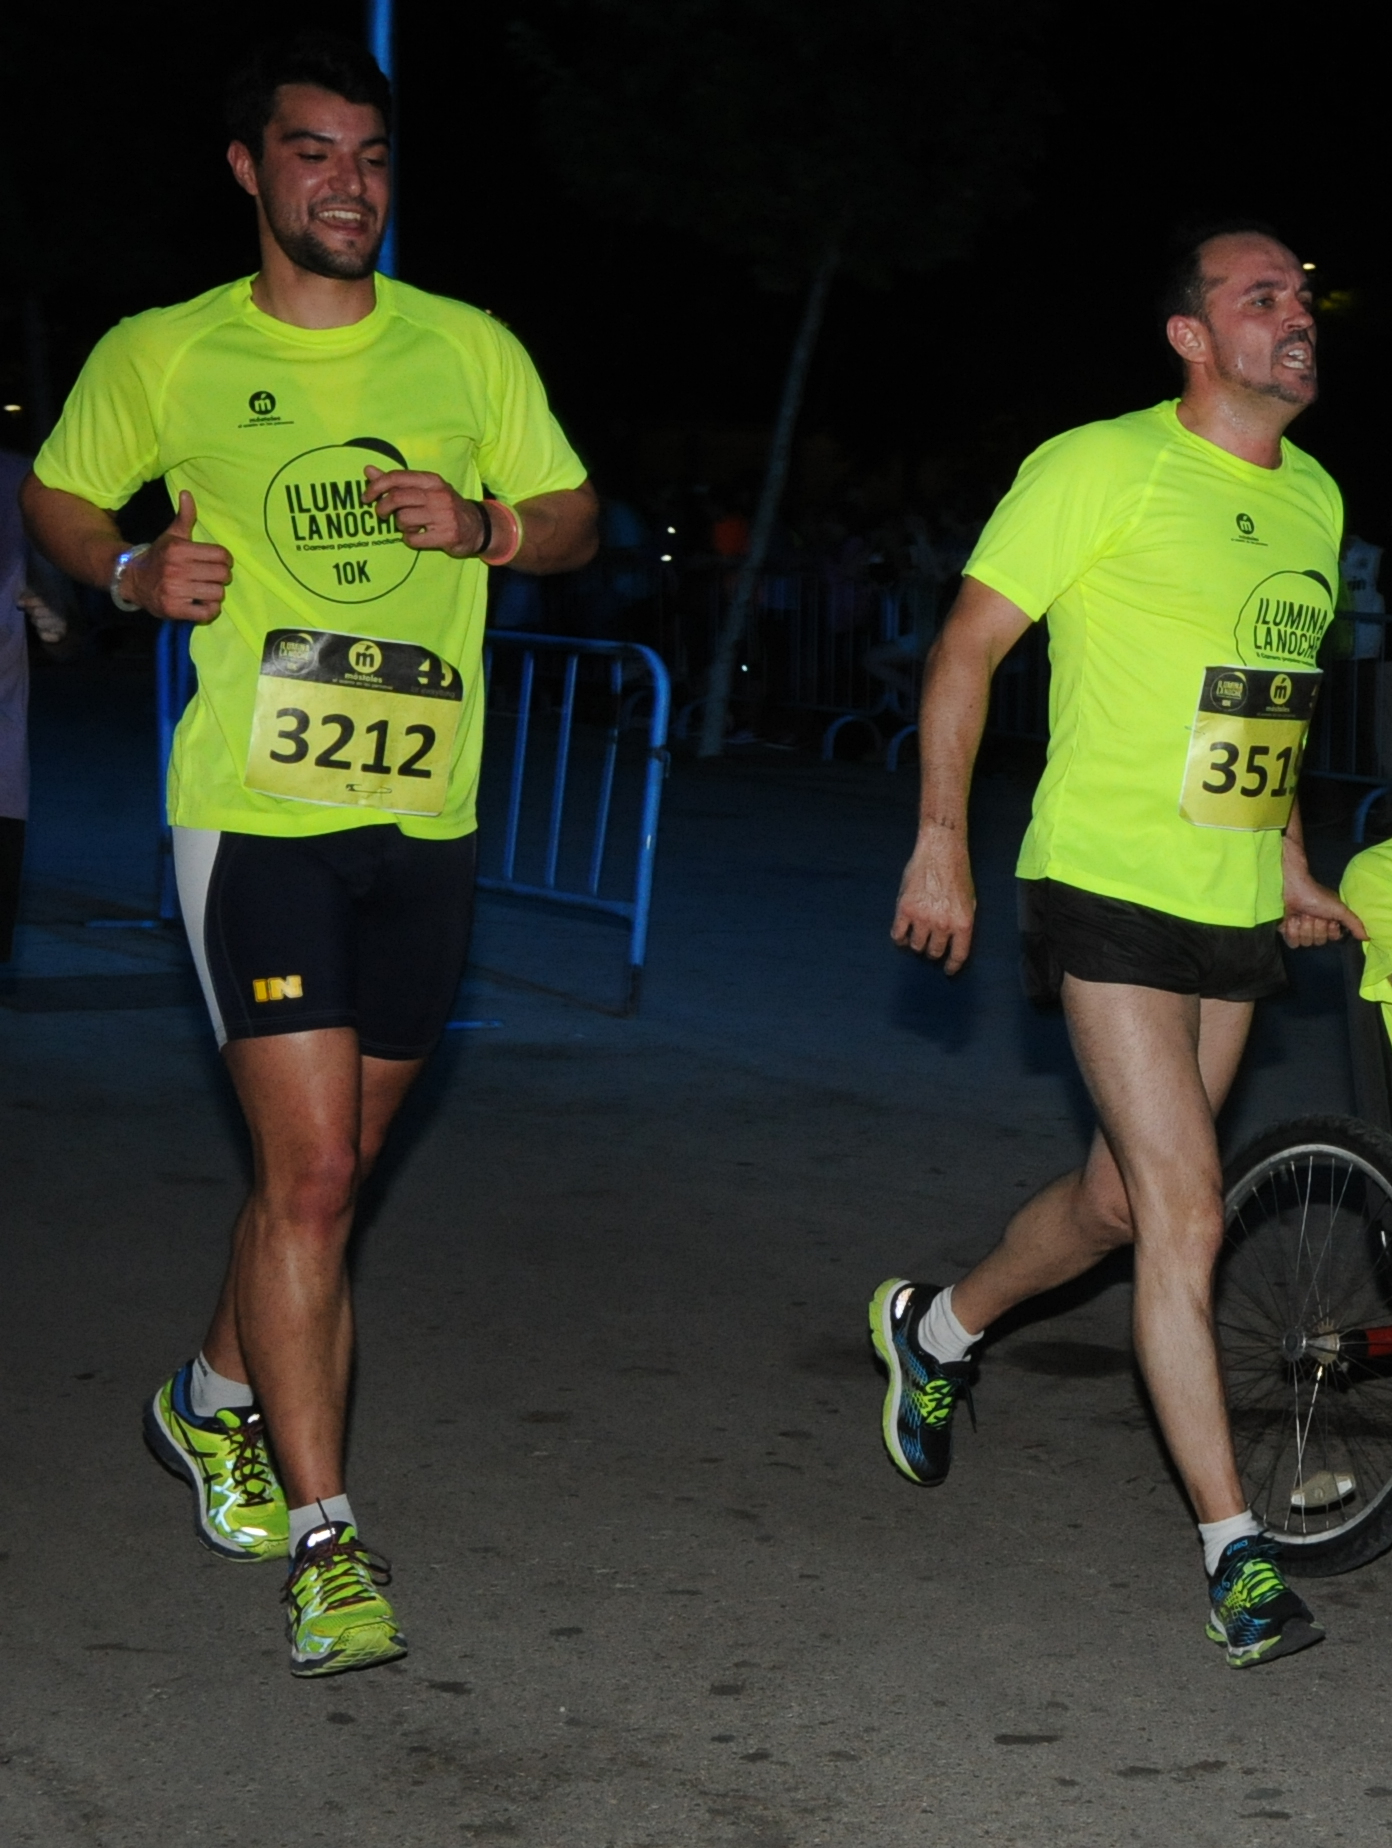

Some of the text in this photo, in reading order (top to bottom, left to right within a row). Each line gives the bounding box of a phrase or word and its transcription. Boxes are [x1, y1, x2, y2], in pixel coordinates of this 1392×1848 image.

[285, 480, 374, 514] ILUMI
[332, 560, 371, 586] 10K
[1255, 597, 1328, 636] ILUMINA
[270, 707, 437, 779] 3212
[1202, 741, 1297, 799] 351
